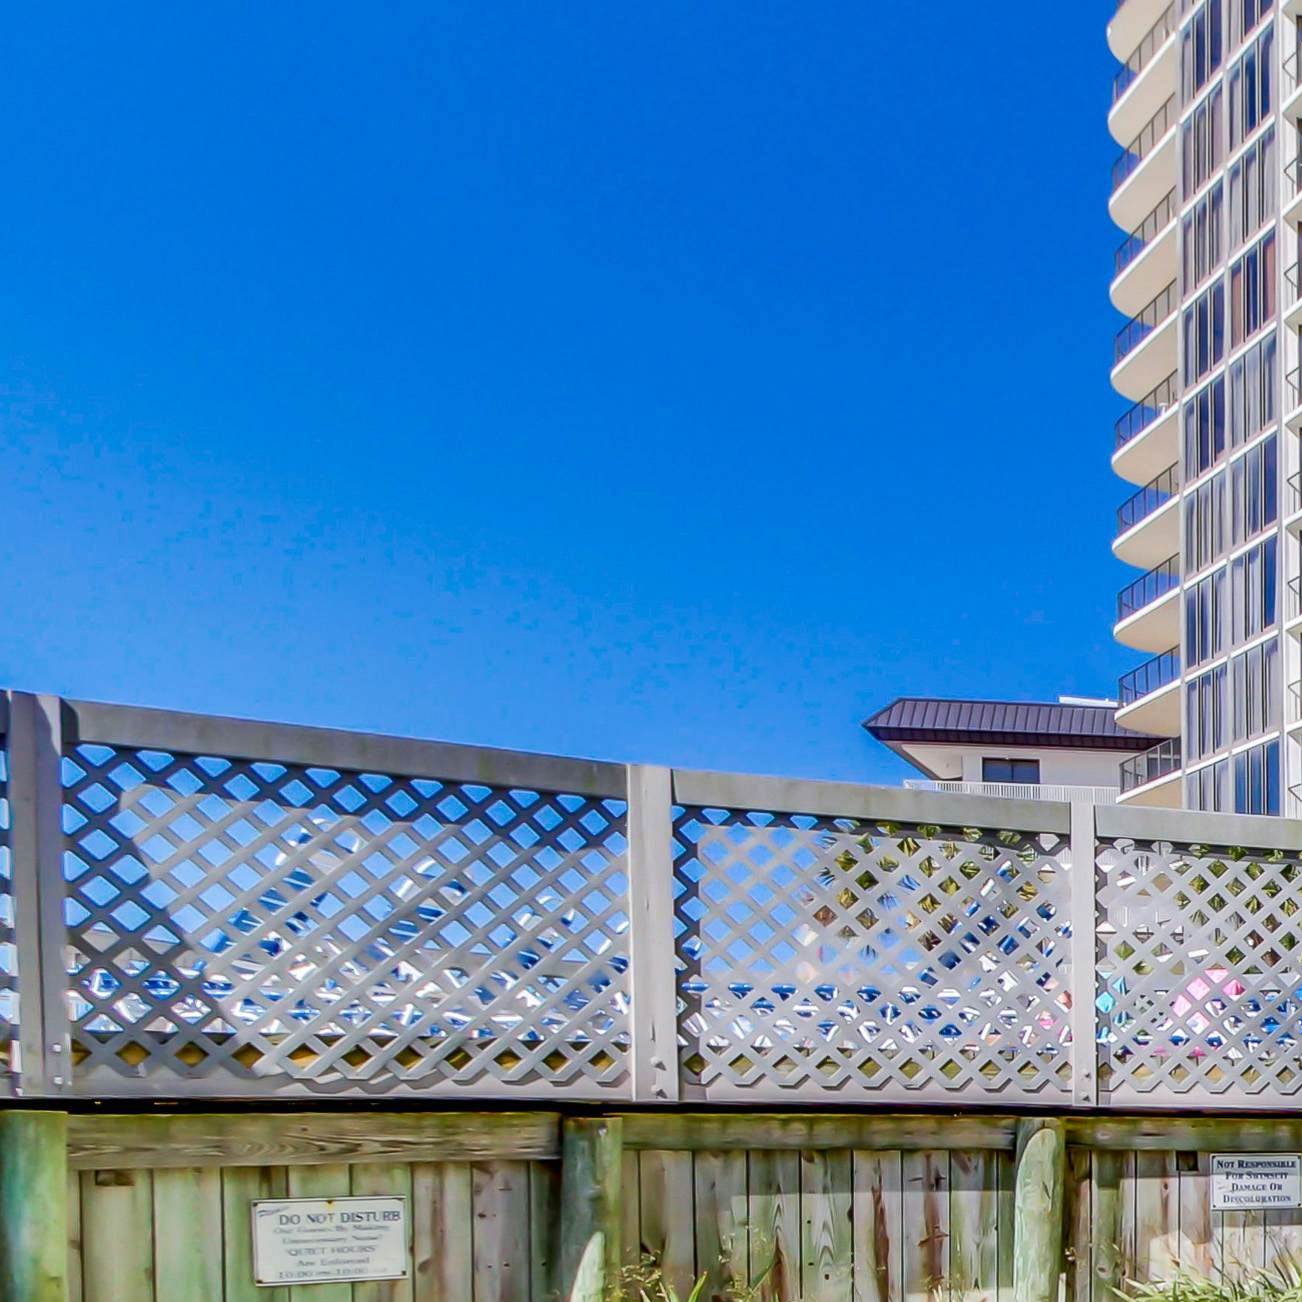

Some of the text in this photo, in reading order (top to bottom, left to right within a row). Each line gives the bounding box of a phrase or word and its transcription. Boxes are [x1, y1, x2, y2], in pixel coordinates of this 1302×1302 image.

[1217, 1160, 1235, 1169] NOT
[279, 1211, 401, 1225] DO NOT DISTURB
